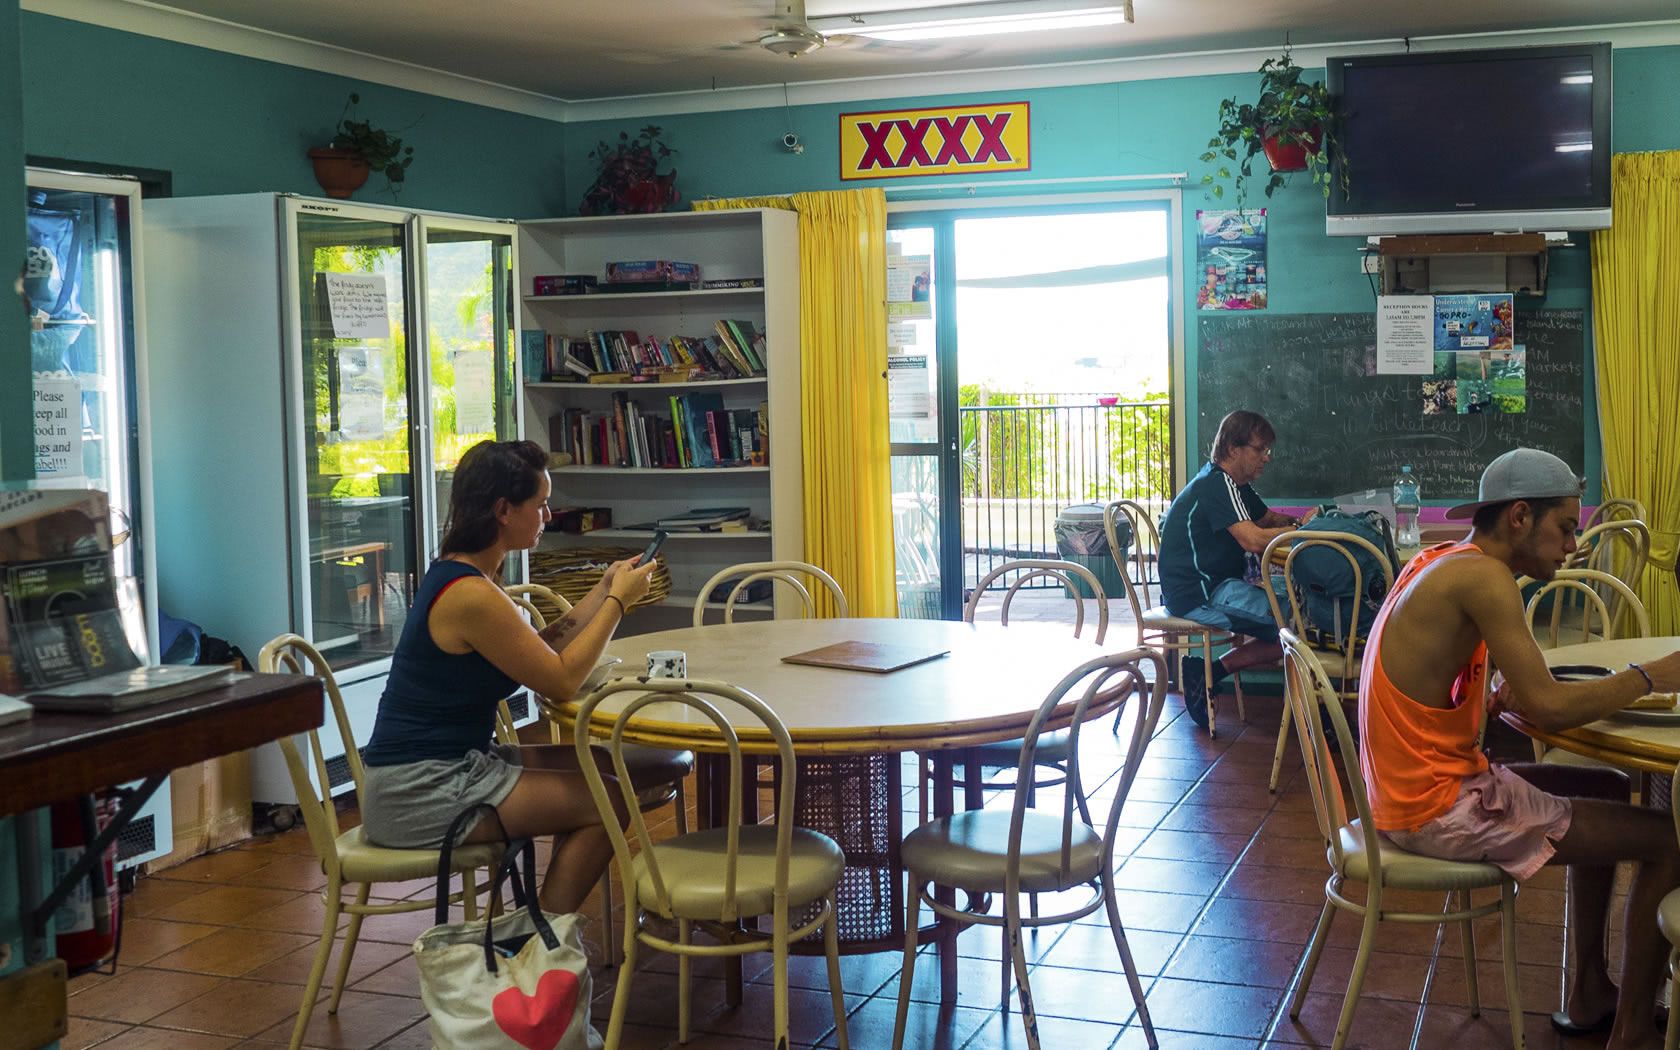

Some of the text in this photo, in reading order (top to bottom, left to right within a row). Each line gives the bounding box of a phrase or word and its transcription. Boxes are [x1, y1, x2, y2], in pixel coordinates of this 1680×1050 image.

[856, 112, 1013, 171] XXXX
[33, 391, 64, 402] Please
[34, 408, 68, 422] eep all
[57, 425, 67, 436] in
[52, 441, 71, 453] and
[35, 458, 68, 470] abel!!!
[35, 643, 69, 661] LIVE
